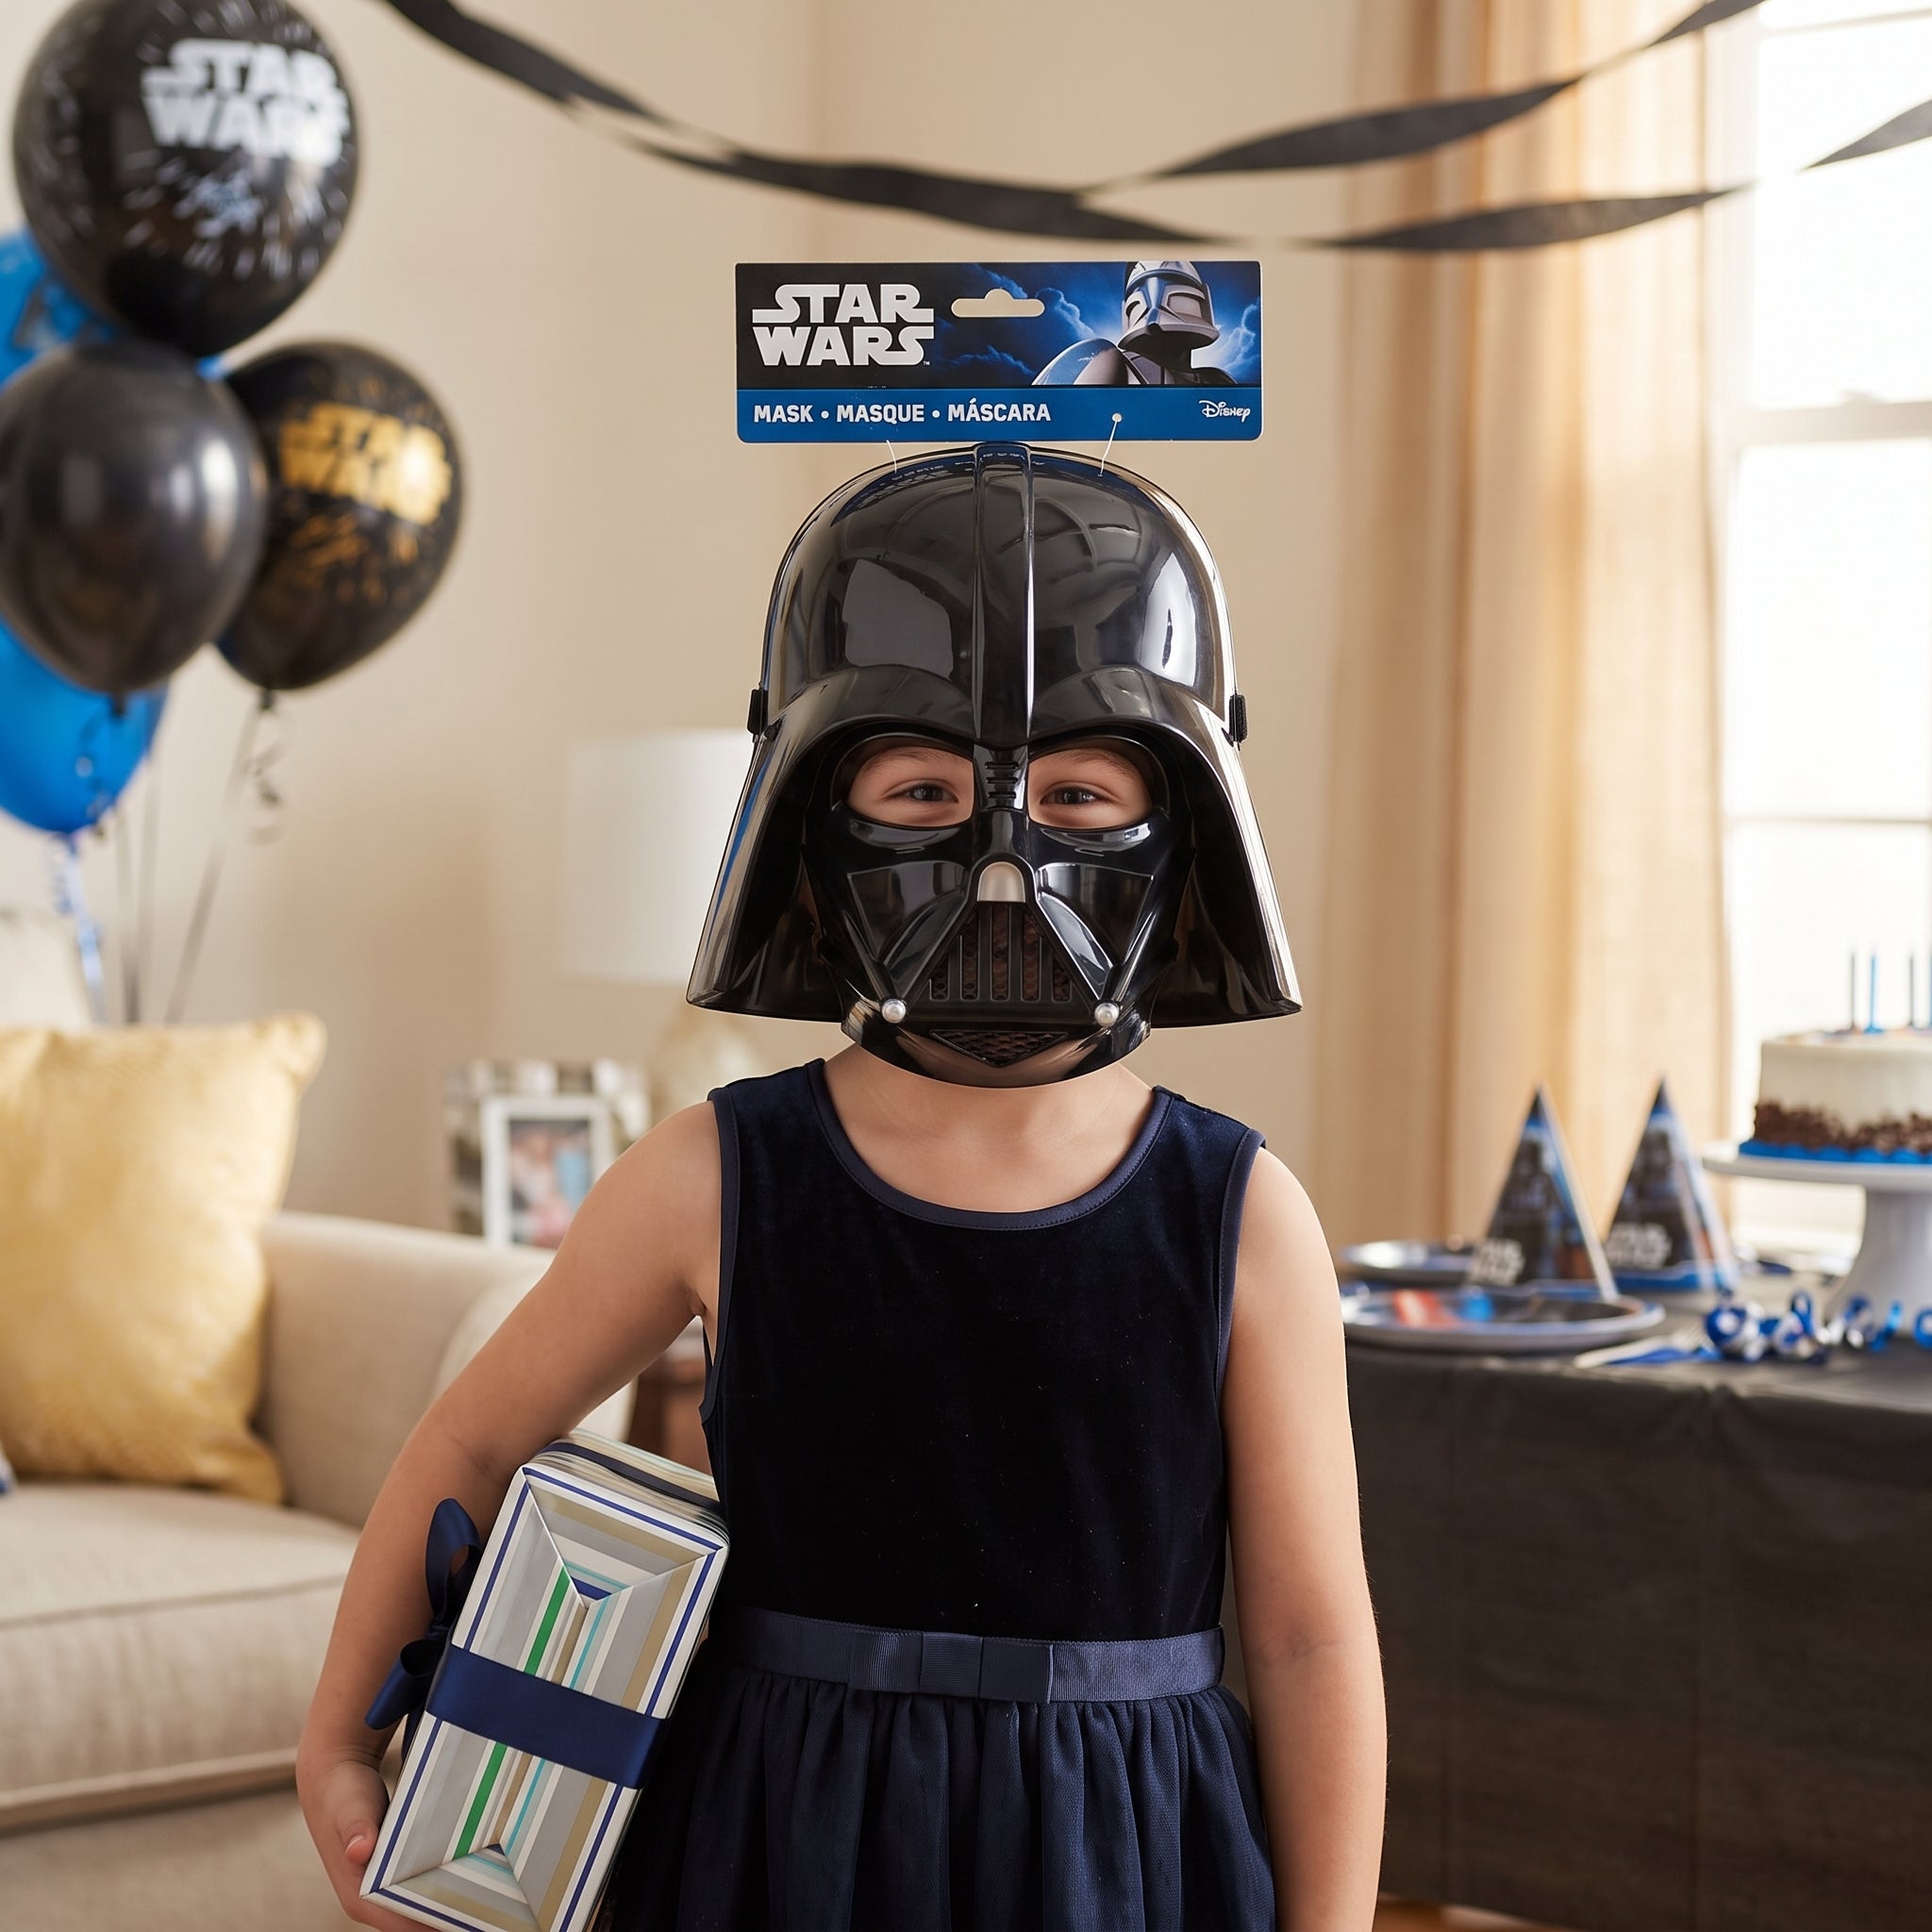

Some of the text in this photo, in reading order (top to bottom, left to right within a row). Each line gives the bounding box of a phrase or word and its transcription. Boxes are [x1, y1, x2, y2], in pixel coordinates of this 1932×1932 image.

[752, 284, 935, 324] STAR
[752, 326, 935, 366] WARS
[754, 398, 1052, 425] MASK MASQUE MÁSCARA
[1198, 400, 1251, 423] Disney
